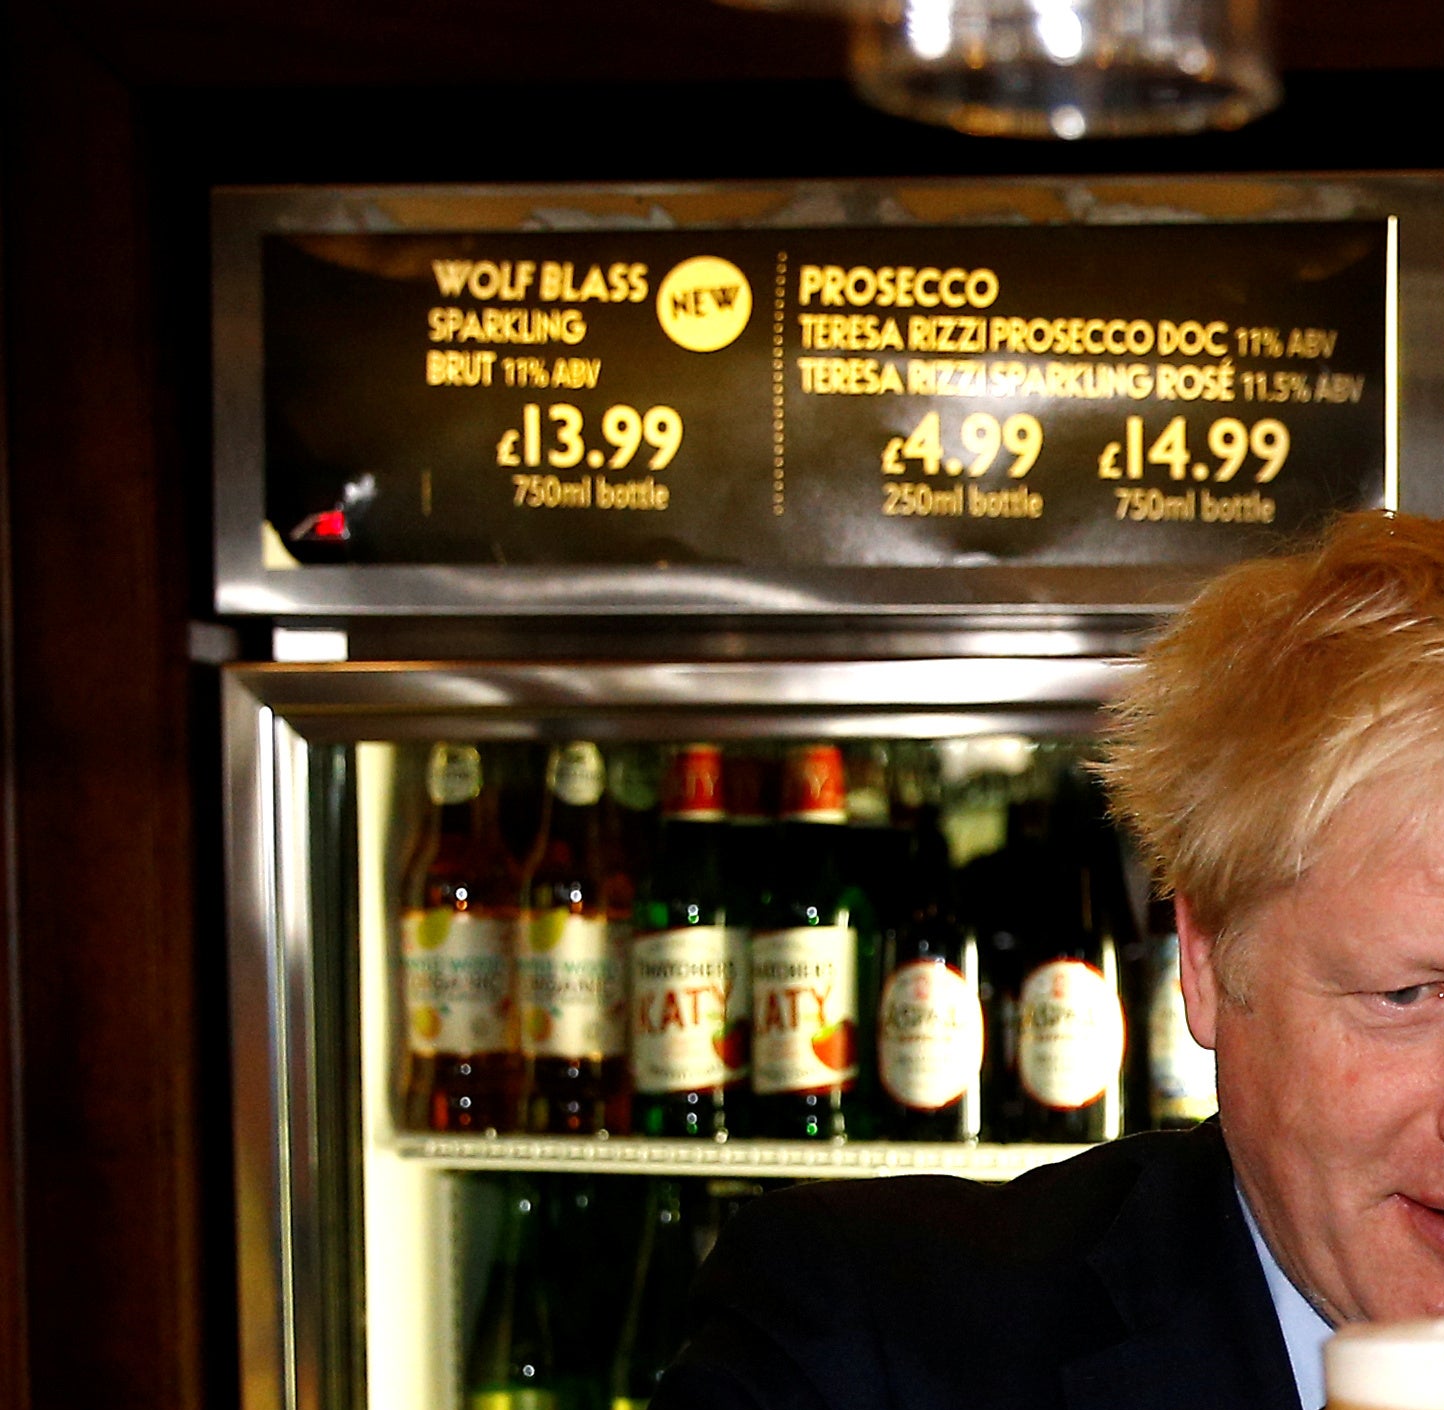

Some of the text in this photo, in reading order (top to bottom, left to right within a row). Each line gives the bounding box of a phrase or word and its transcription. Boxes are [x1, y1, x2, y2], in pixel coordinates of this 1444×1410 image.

[432, 260, 648, 304] WOLF BLASS
[671, 285, 741, 320] NEW
[799, 266, 999, 308] PROSECCO
[427, 309, 587, 346] SPARKLING
[799, 315, 1338, 359] TERESA RIZZI PROSECCO DOC 11% ABV
[426, 351, 601, 390] BRUT 11% ABV
[797, 356, 1365, 404] TERESA RIZZI SPARKLING ROSÉ 11.5% ABV
[496, 403, 684, 471] £13.99
[881, 411, 1291, 483] £4.99 £14.99
[512, 474, 670, 512] 750ml bottle
[881, 483, 1044, 518] 250ml bottle
[1114, 486, 1276, 523] 750ml bottle
[637, 980, 732, 1034] KATY
